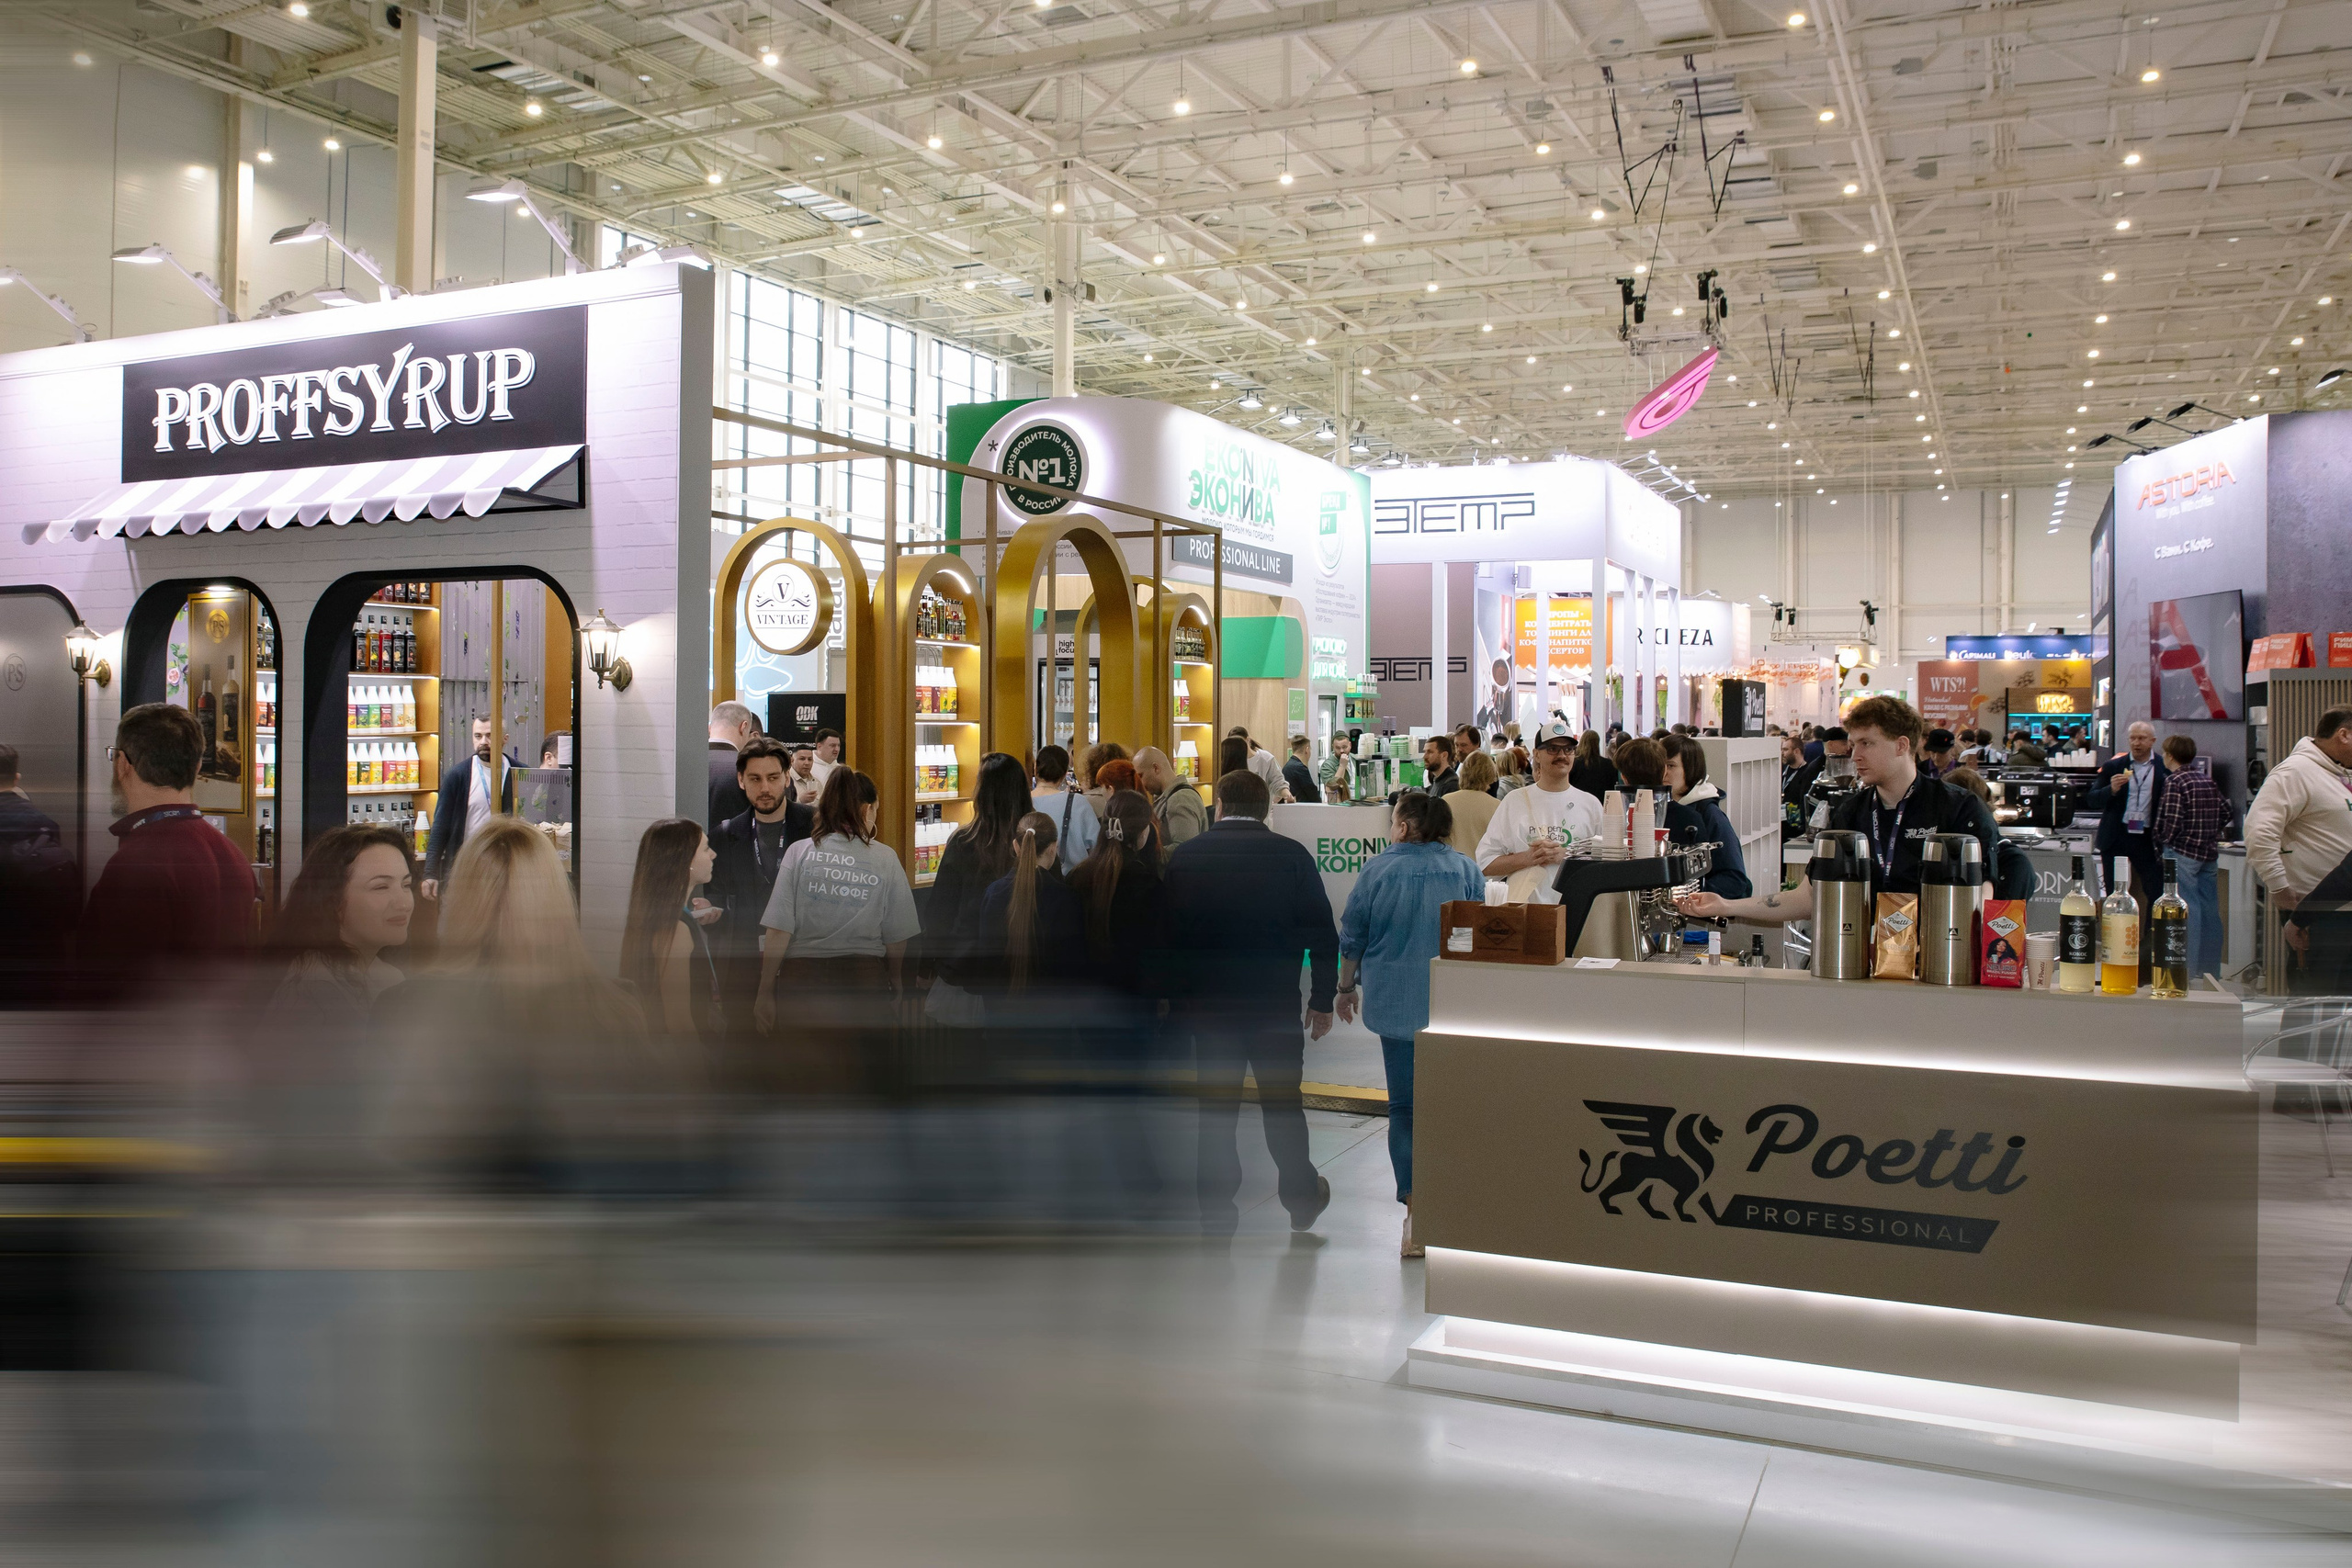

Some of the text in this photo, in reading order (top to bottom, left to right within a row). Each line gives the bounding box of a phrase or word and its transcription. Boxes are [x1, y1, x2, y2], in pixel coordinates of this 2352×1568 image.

[152, 343, 537, 454] PROFFSYRUP
[1007, 431, 1078, 491] ОИЗВОДИТЕЛЬ МОЛОКА
[1018, 457, 1066, 484] №1
[2137, 461, 2236, 511] ASTORIA
[1017, 494, 1024, 503] В
[1188, 469, 1275, 527] ЭКОНИВА
[1190, 537, 1281, 574] PROFSSIONAL LINE
[777, 582, 789, 600] V
[757, 614, 808, 625] VINTAGE
[1930, 677, 1967, 693] WTS?!
[796, 705, 819, 721] ODK
[1317, 838, 1392, 855] EKONIV
[806, 851, 855, 866] ЛЕТАЮ
[823, 867, 879, 886] ТОЛЬКО
[808, 882, 869, 900] НА КОФЕ
[1888, 917, 1909, 925] Poetti
[1991, 920, 2016, 930] Poetti
[1986, 964, 2018, 972] NEURO
[1745, 1104, 2029, 1194] Poetti
[1746, 1204, 1973, 1244] PROFESSIONAL
